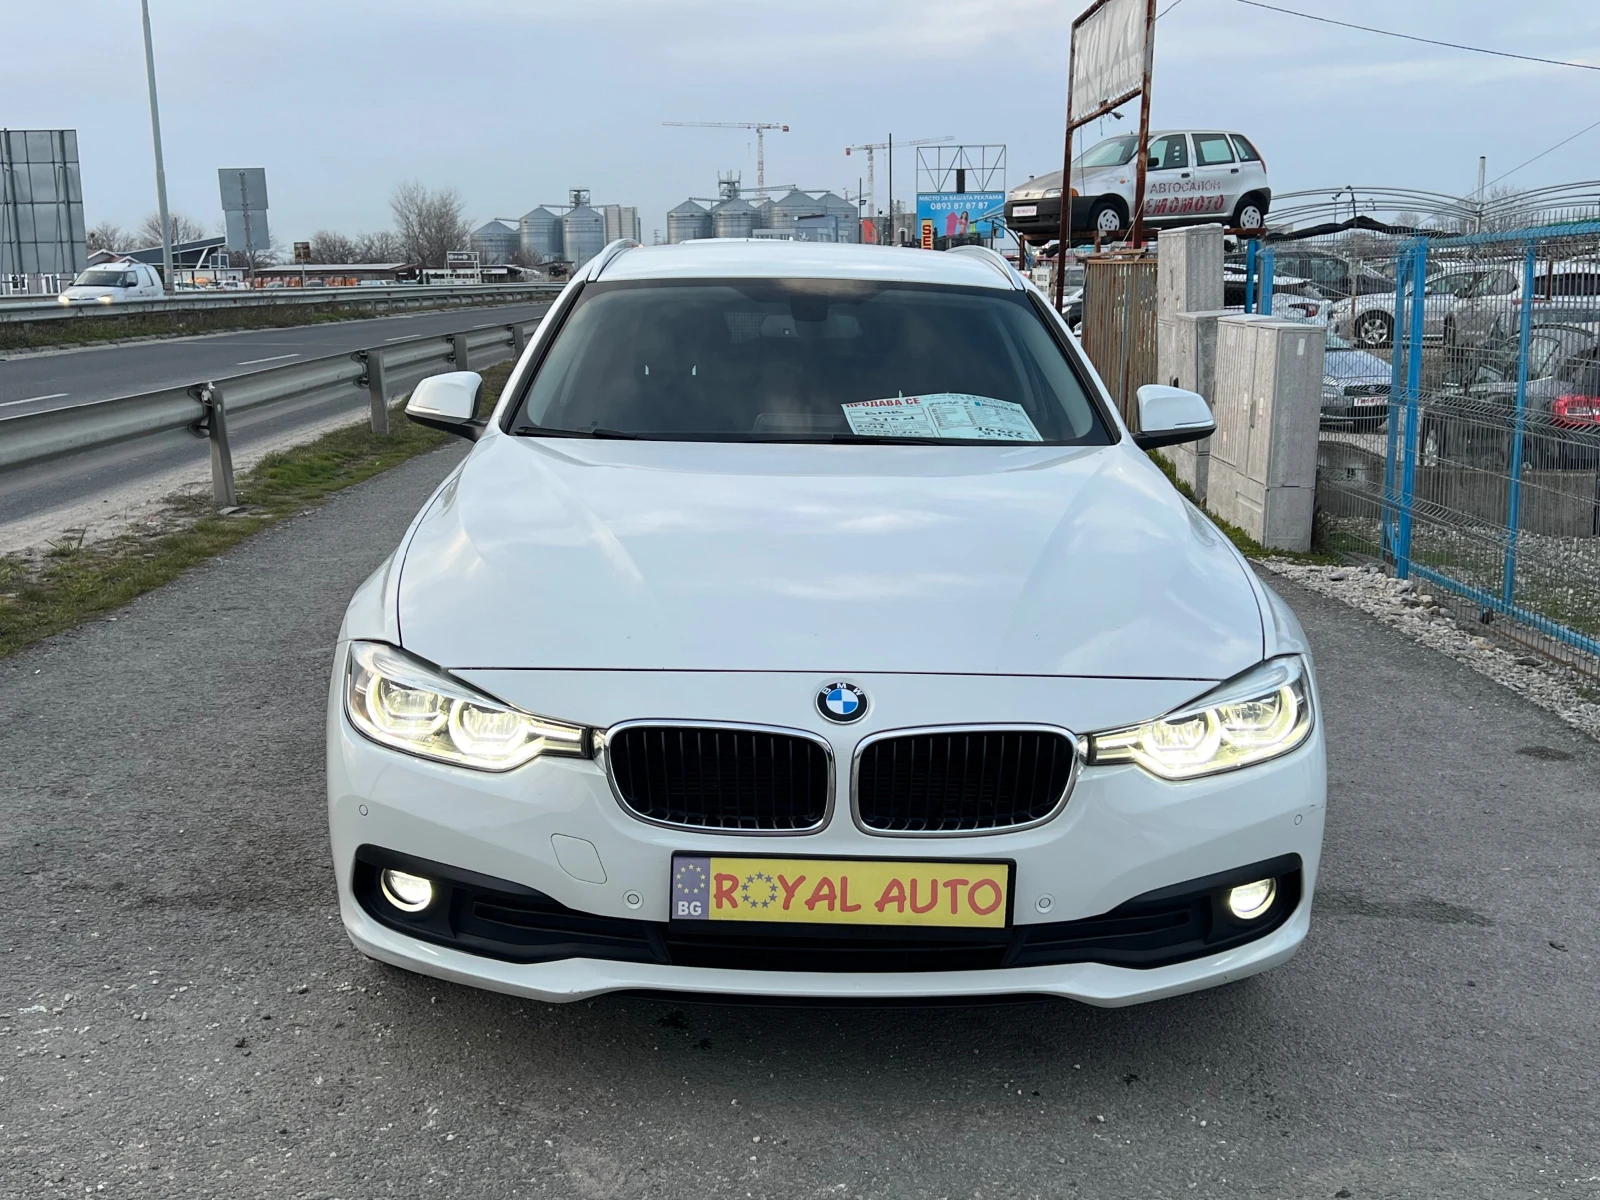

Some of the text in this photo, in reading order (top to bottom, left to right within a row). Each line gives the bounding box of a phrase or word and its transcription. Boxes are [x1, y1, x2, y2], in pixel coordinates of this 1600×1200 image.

[930, 201, 989, 210] 0893 87 87 87
[922, 224, 932, 250] SE
[845, 399, 903, 408] ПРОДАВА
[905, 397, 921, 405] СЕ
[821, 682, 864, 696] BMW
[714, 871, 1003, 916] ROYAL AUTO
[677, 901, 702, 916] BG
